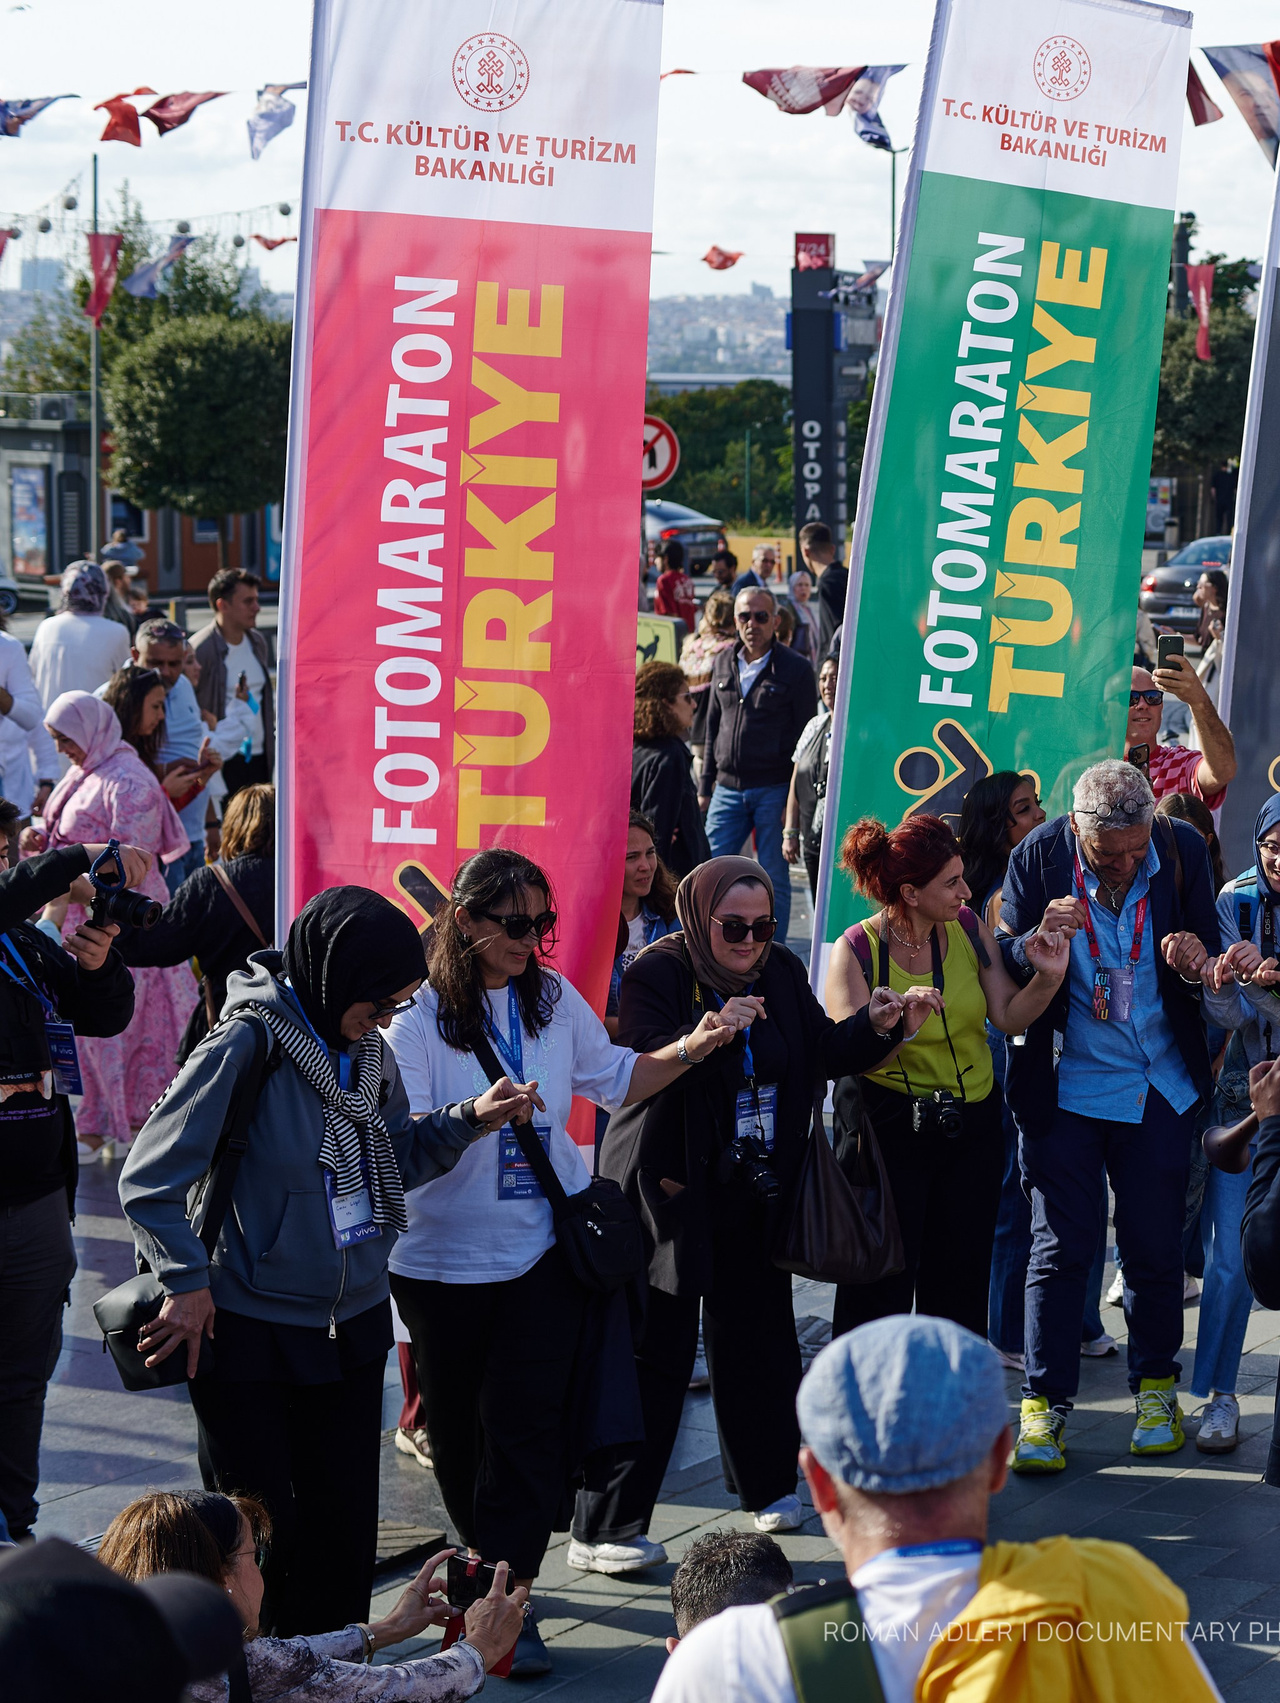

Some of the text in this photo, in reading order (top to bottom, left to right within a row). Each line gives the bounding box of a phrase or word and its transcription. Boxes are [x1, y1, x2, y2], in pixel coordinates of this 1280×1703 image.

[335, 120, 637, 165] T.C. KÜLTÜR VE TURİZM
[942, 98, 1167, 154] T.C. KÜLTÜR VE TURİZM
[414, 154, 556, 187] BAKANLIĞI
[999, 132, 1107, 167] BAKANLIĞI
[919, 230, 1026, 708] FOTOMARATON
[371, 275, 459, 845] FOTOMARATON
[355, 1226, 376, 1237] vivo
